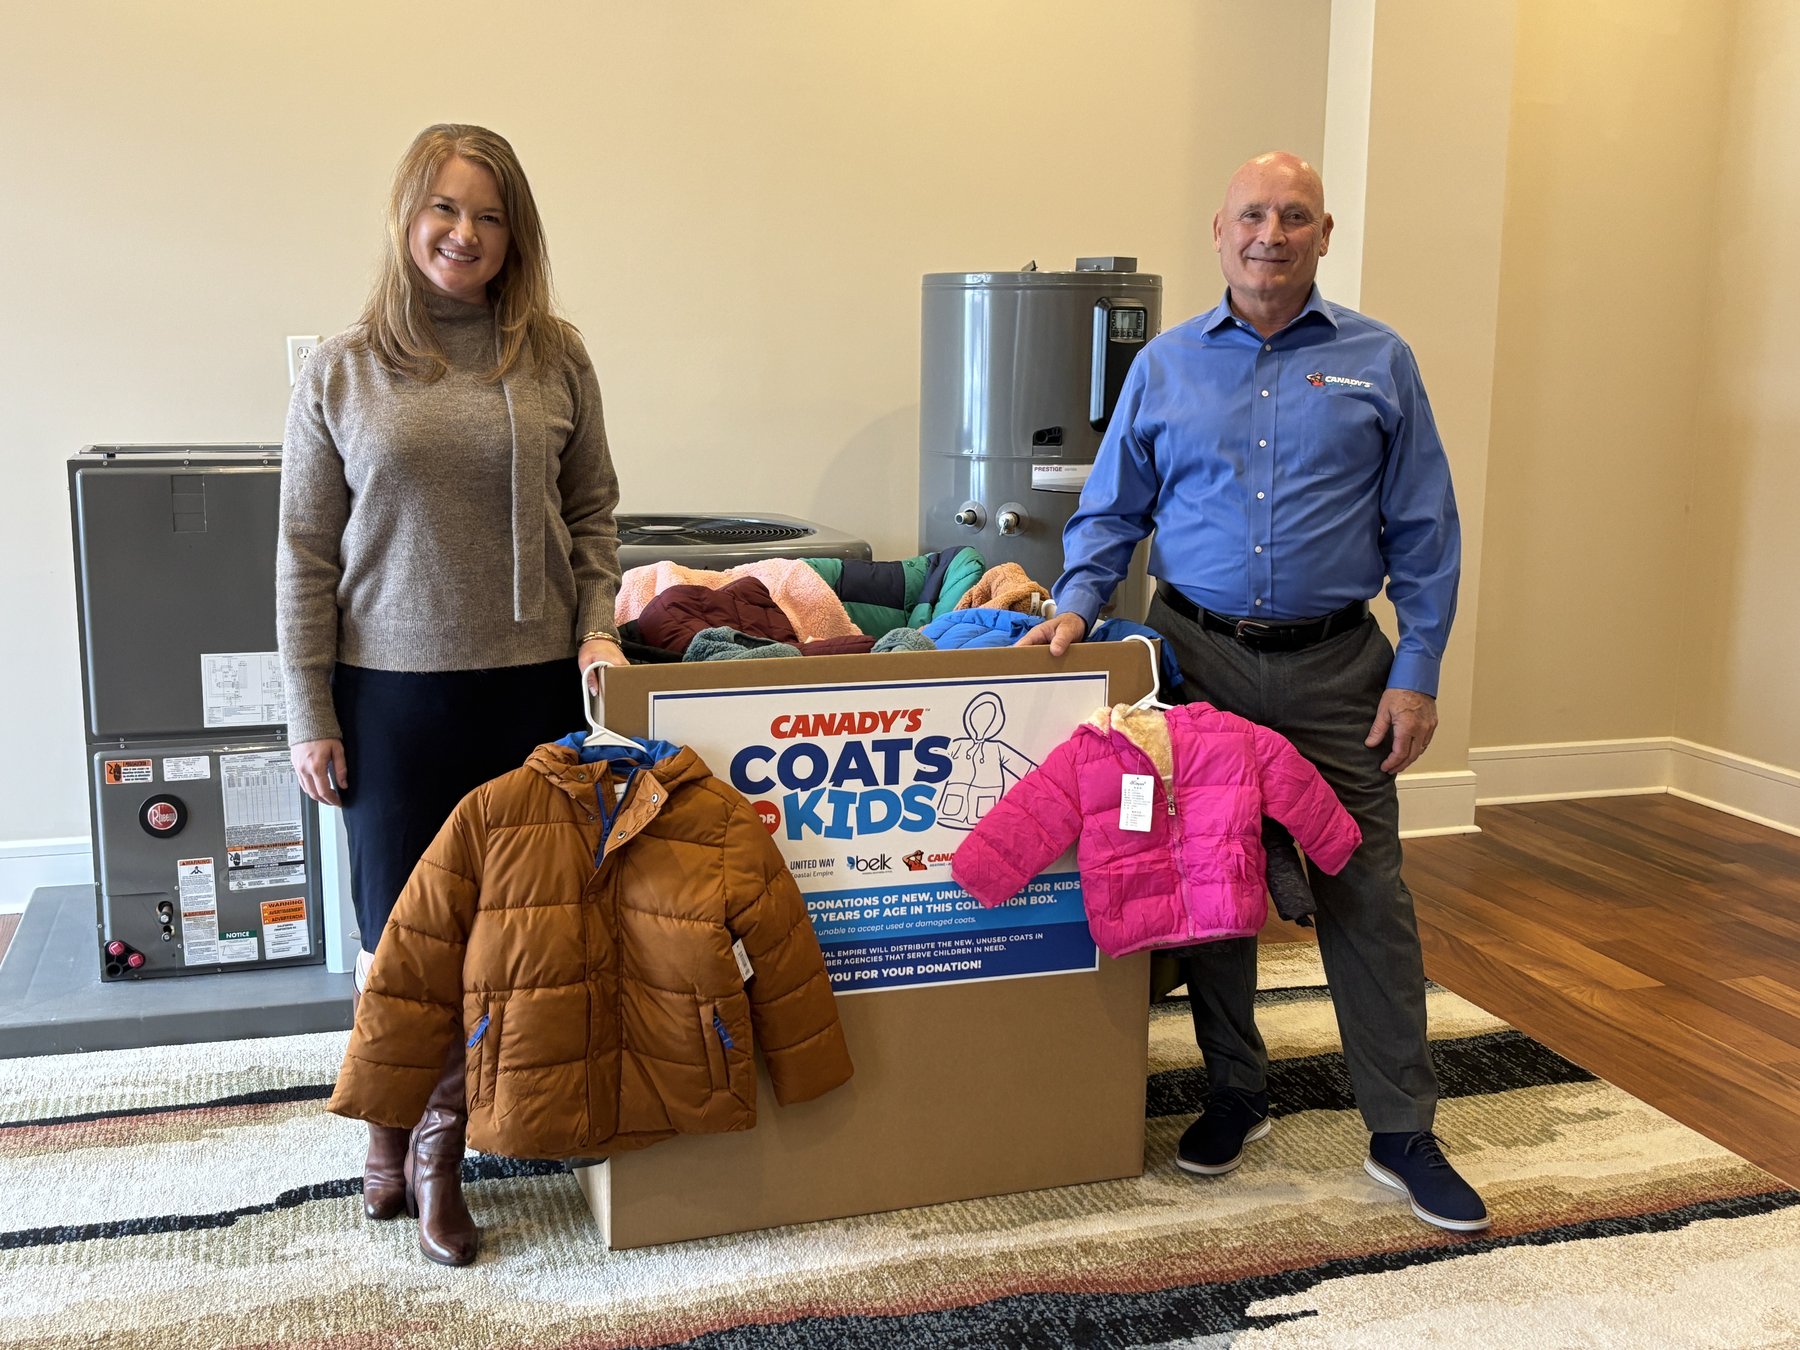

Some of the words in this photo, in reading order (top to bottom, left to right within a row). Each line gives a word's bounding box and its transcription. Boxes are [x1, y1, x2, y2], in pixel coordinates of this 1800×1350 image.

[1324, 375, 1372, 388] CANADY'S
[770, 708, 924, 739] CANADY'S
[729, 735, 953, 795] COATS
[783, 783, 938, 841] KIDS
[790, 859, 817, 870] UNITED
[818, 858, 835, 868] WAY
[856, 853, 893, 872] belk
[813, 870, 834, 878] Empire
[268, 899, 303, 908] WARNING
[807, 896, 879, 911] DONATIONS
[882, 894, 899, 905] OF
[902, 892, 933, 903] NEW,
[1028, 883, 1051, 893] FOR
[1054, 881, 1081, 891] KIDS
[820, 910, 860, 922] YEARS
[864, 908, 880, 919] OF
[883, 906, 907, 917] AGE
[910, 905, 923, 915] IN
[927, 902, 952, 913] THIS
[1030, 894, 1057, 904] BOX.
[225, 931, 250, 939] NOTICE
[818, 927, 846, 936] unable
[847, 926, 856, 934] to
[857, 924, 884, 934] accept
[885, 921, 904, 930] used
[915, 915, 953, 929] damaged
[954, 917, 976, 925] coats.
[837, 948, 867, 957] EMPIRE
[869, 946, 889, 955] WILL
[890, 942, 936, 952] DISTRIBUTE
[937, 940, 953, 948] THE
[976, 936, 1007, 945] UNUSED
[1009, 933, 1034, 942] COATS
[1035, 932, 1044, 940] IN
[844, 955, 883, 965] AGENCIES
[885, 953, 905, 962] THAT
[907, 951, 932, 960] SERVE
[933, 947, 972, 957] CHILDREN
[974, 946, 982, 954] IN
[984, 944, 1007, 953] NEED.
[828, 971, 852, 983] YOU
[854, 968, 879, 980] FOR
[881, 965, 914, 977] YOUR
[917, 960, 982, 975] DONATION!
